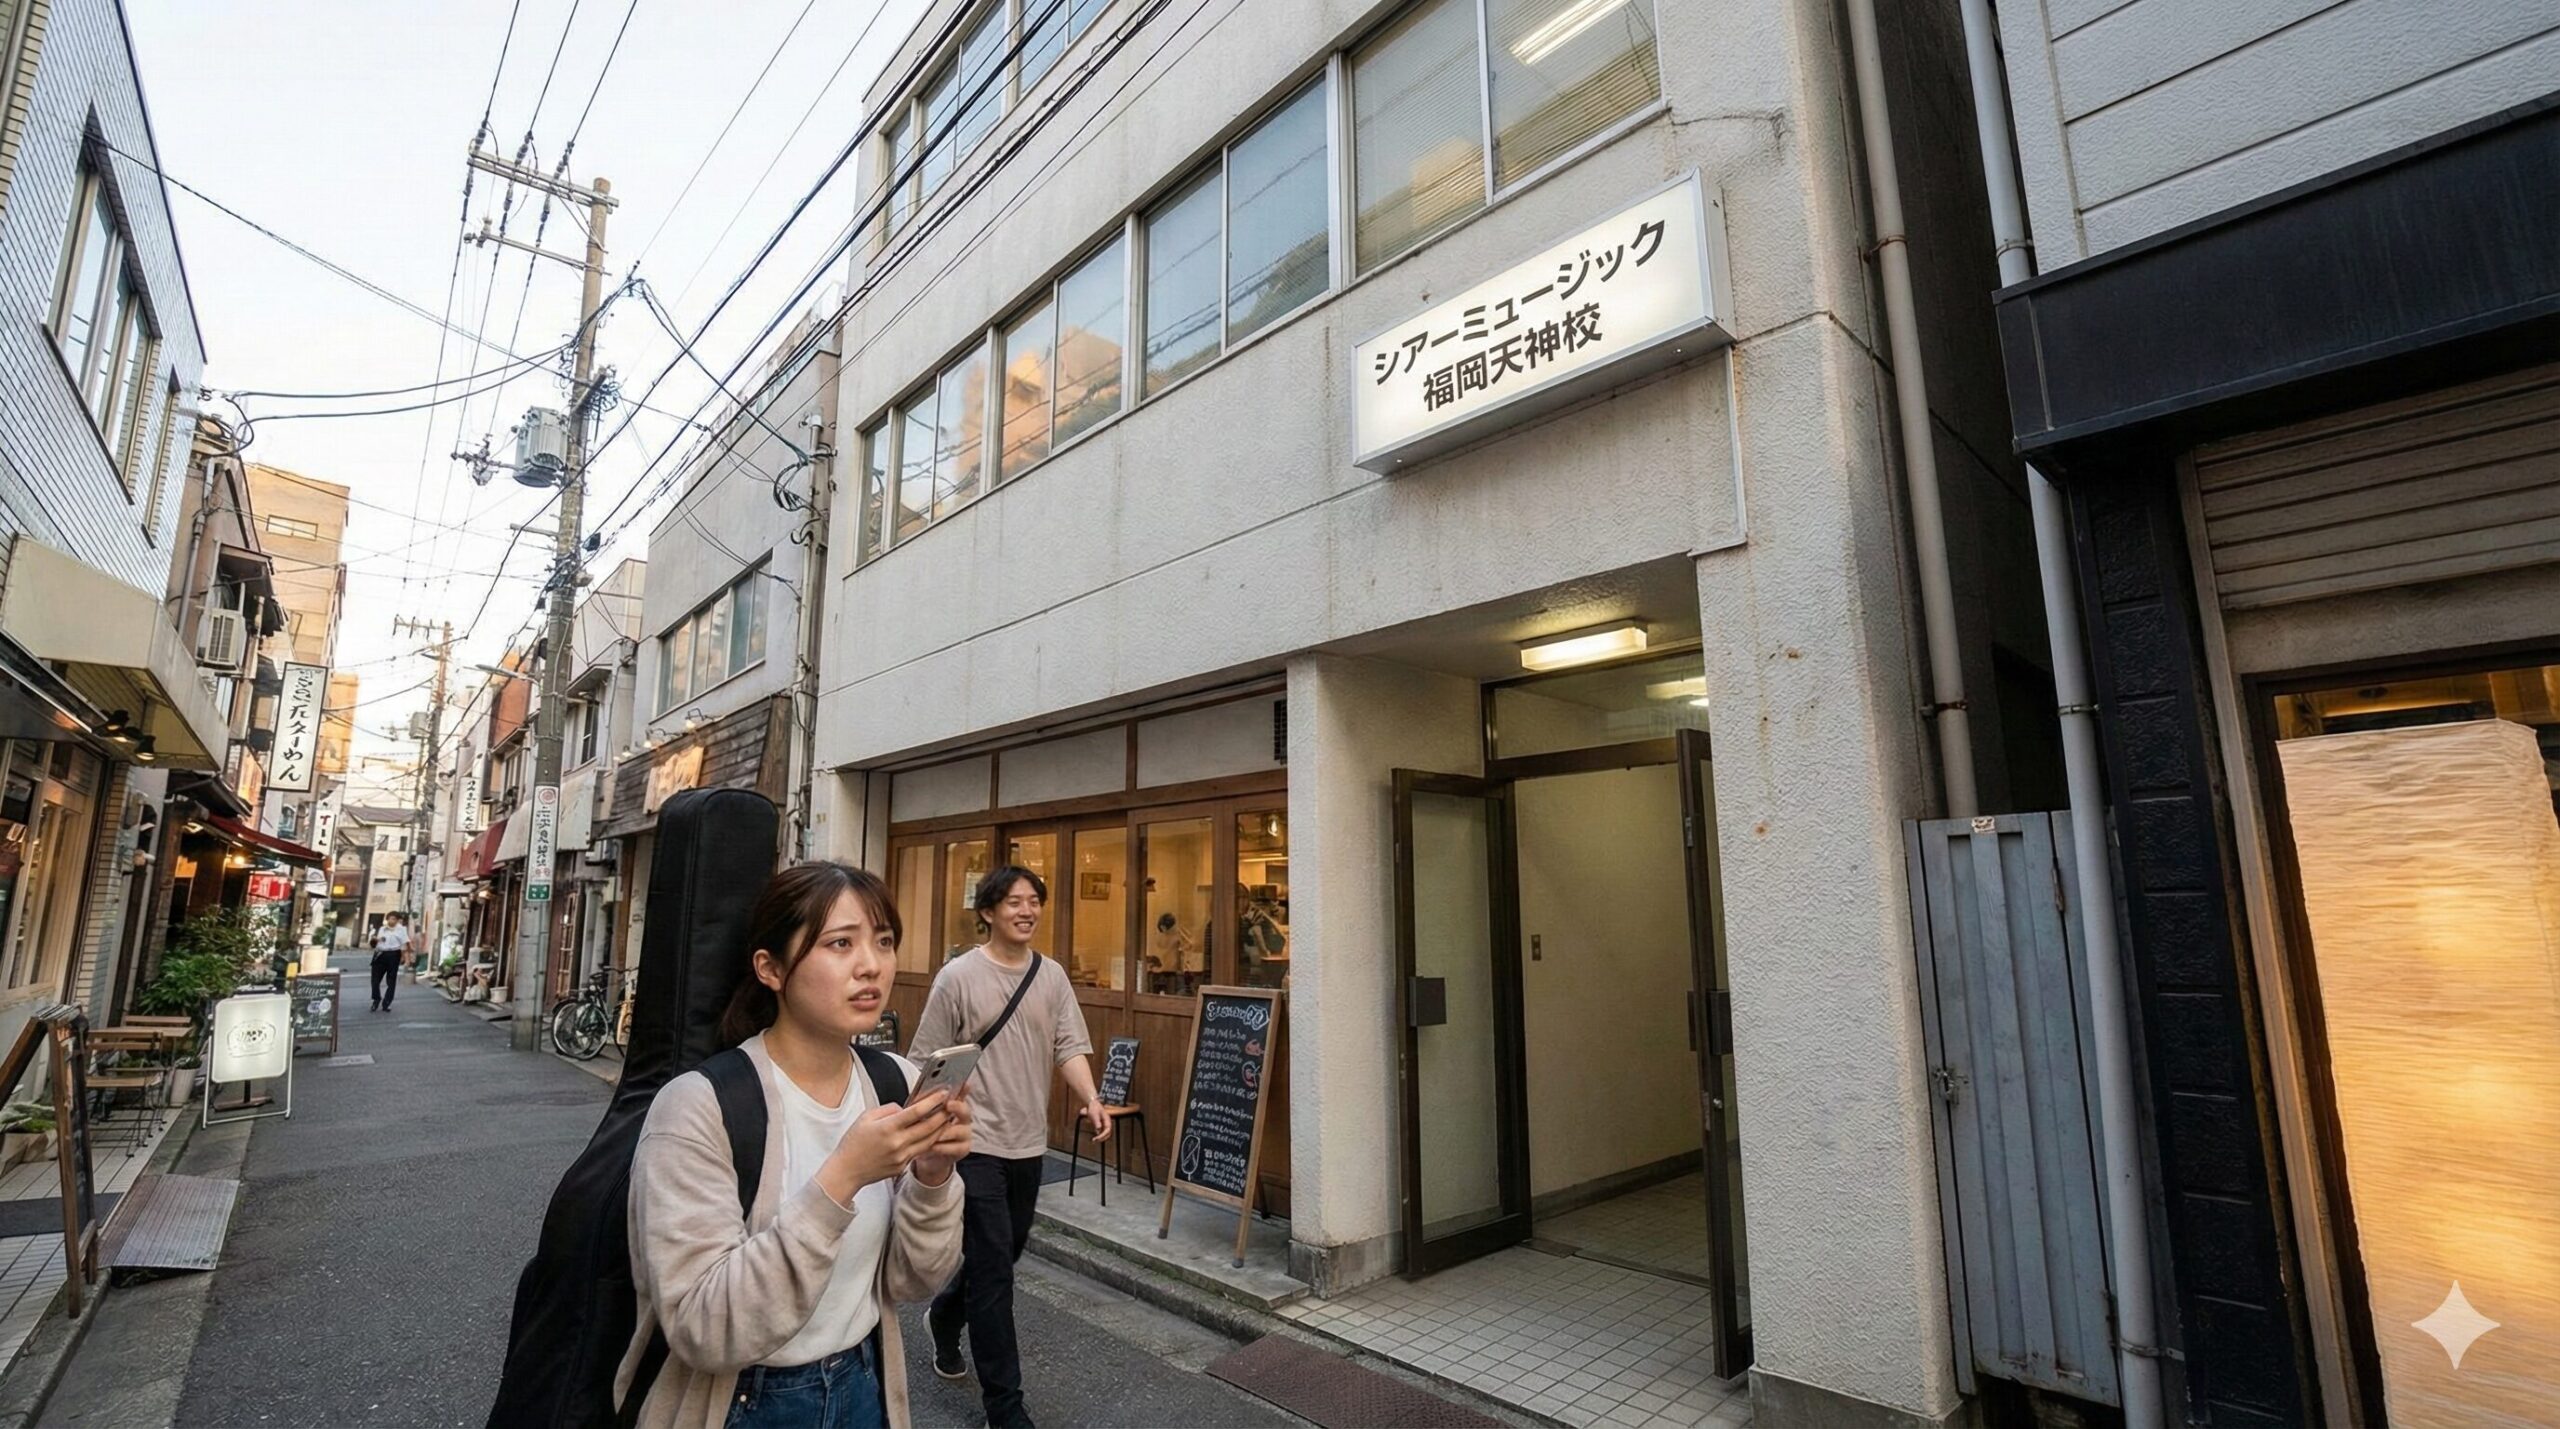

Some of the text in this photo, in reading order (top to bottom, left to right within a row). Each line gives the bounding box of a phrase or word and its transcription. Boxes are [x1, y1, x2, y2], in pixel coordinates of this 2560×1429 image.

[1374, 219, 1665, 386] シアーミュージック
[1423, 302, 1603, 412] 福岡天神校
